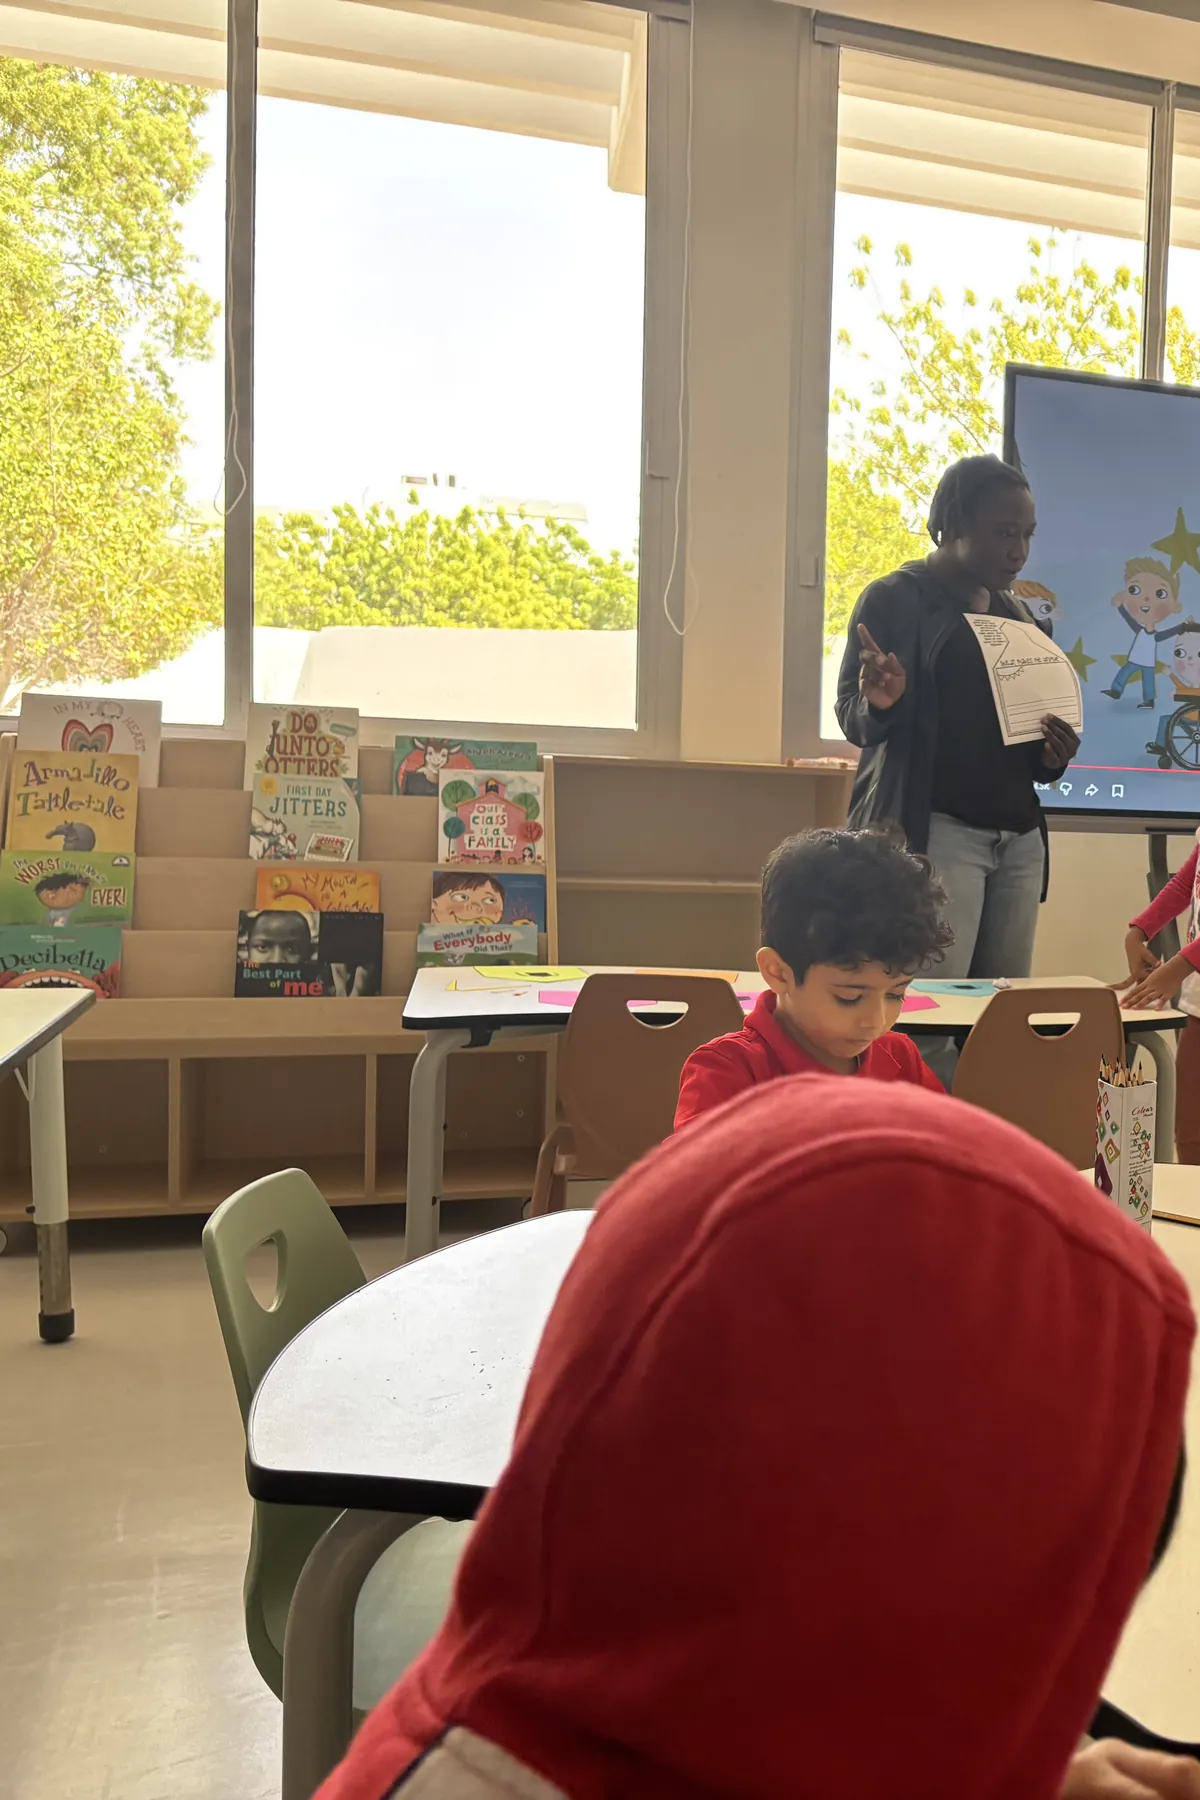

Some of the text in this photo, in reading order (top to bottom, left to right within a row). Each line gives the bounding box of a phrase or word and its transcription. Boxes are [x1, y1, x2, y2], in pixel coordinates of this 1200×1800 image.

[53, 700, 146, 752] IN MY HEART
[290, 710, 318, 734] DO
[275, 734, 330, 757] UNTO
[23, 758, 130, 791] Armadillo
[264, 757, 339, 778] OTTERS
[286, 783, 332, 797] FIRST DAY
[16, 786, 125, 820] Tattletale
[269, 797, 347, 818] JITTERS
[468, 837, 515, 850] FAMILY
[14, 857, 61, 885] WORST
[92, 886, 126, 906] EVER!
[433, 931, 511, 952] Everybody
[442, 931, 461, 941] What
[0, 943, 106, 971] Decibella
[243, 961, 260, 969] The
[243, 968, 301, 979] Best Part
[269, 980, 324, 996] of me
